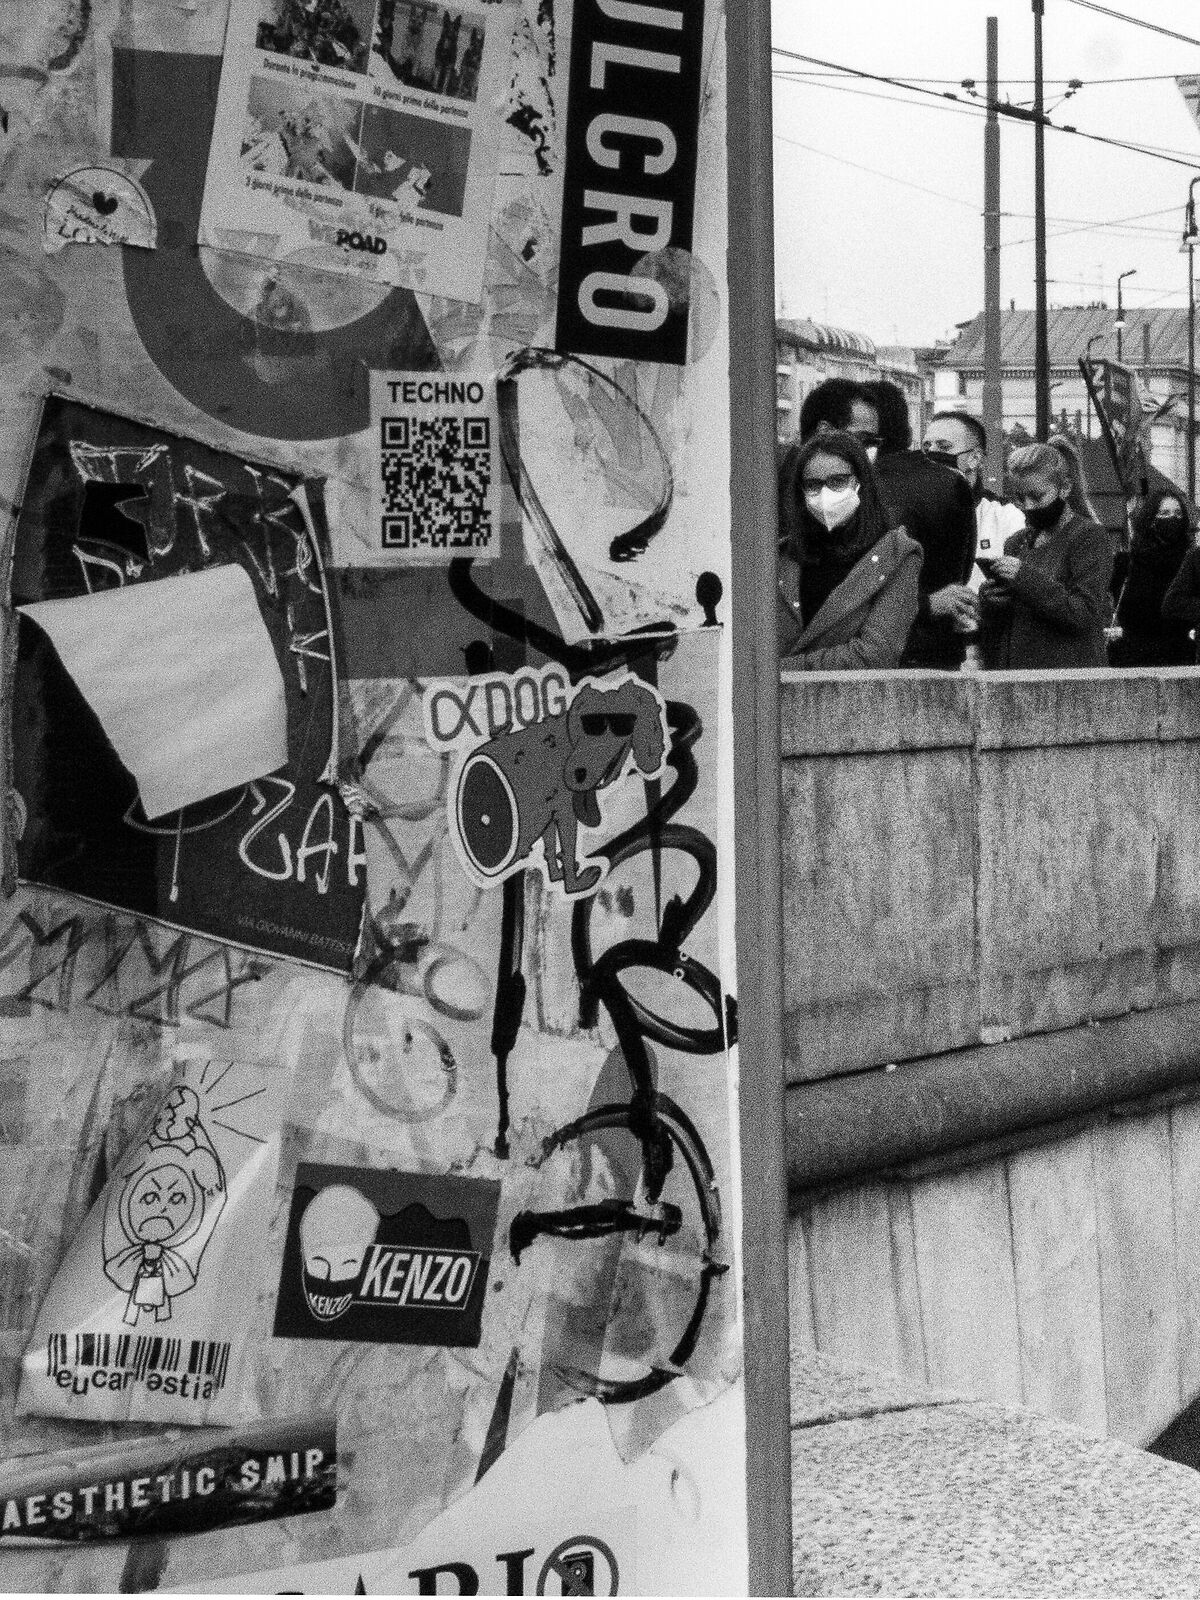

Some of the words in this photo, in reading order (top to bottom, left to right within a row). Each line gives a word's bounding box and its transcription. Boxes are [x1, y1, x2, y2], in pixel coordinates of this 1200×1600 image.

[387, 381, 484, 404] TECHNO
[360, 1246, 472, 1305] KENZO
[309, 1293, 352, 1315] KENZO
[2, 1468, 216, 1530] AESTHETIC
